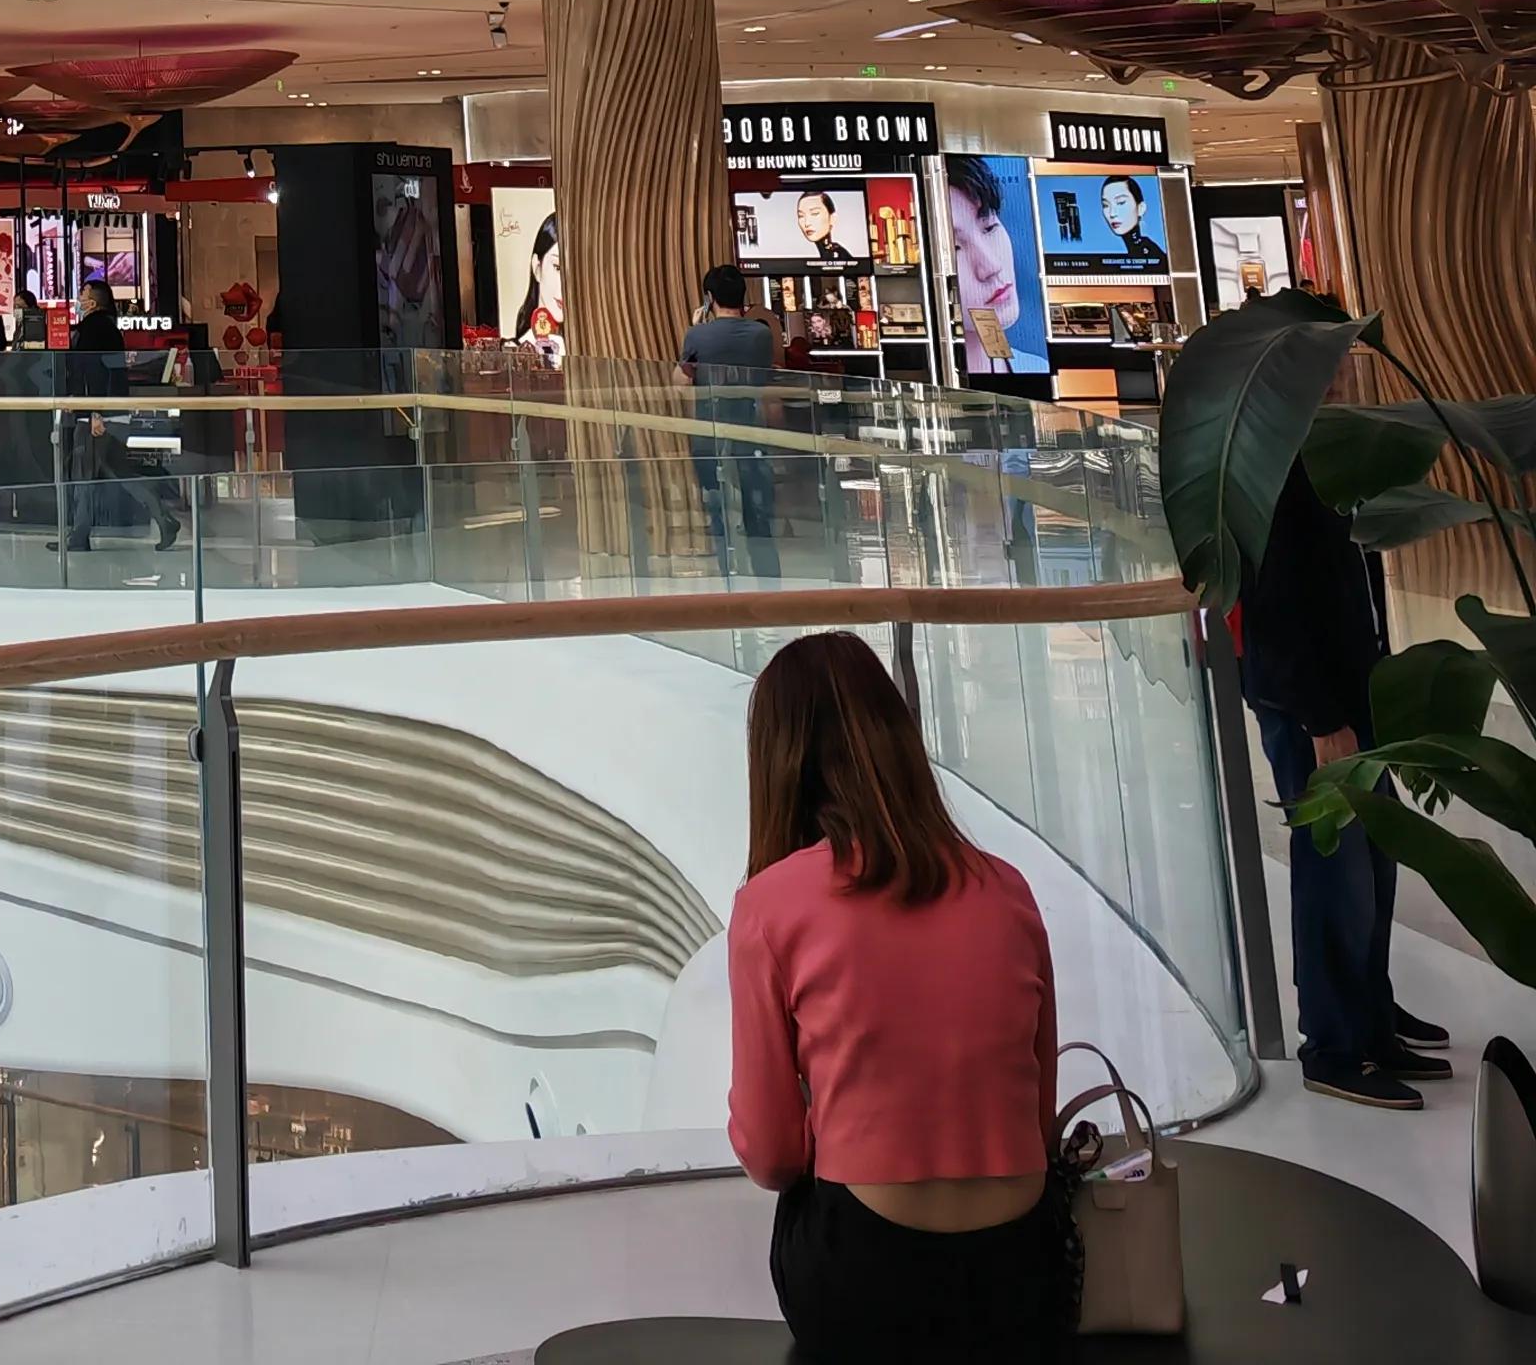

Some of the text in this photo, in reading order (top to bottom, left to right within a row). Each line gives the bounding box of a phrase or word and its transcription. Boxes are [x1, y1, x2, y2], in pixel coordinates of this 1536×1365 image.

[722, 115, 928, 144] BOBBI BROWN
[1058, 124, 1162, 153] BOBBI BROWN
[376, 152, 432, 168] shu uemura
[811, 153, 862, 169] STUDIO
